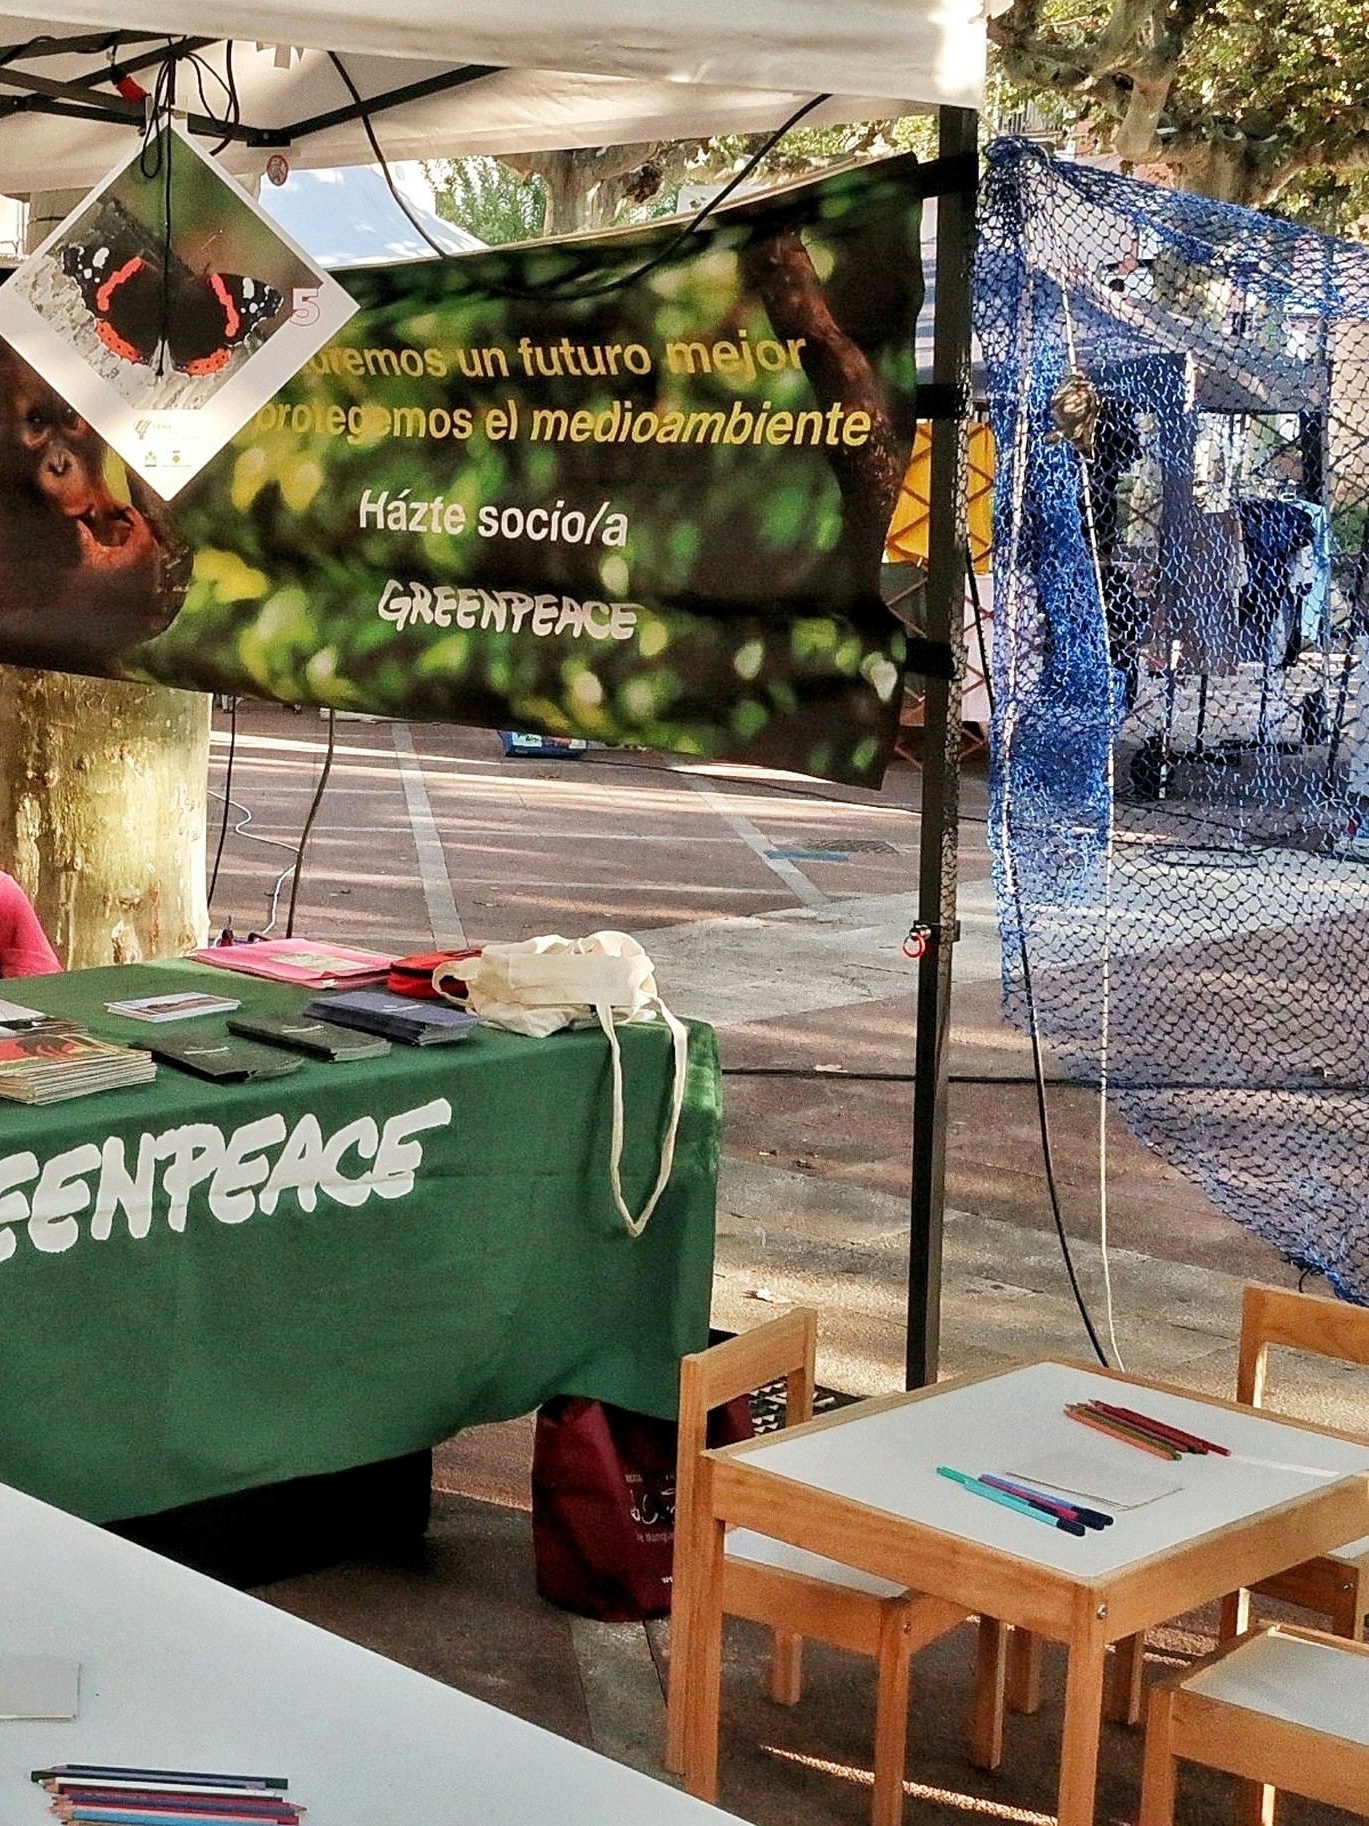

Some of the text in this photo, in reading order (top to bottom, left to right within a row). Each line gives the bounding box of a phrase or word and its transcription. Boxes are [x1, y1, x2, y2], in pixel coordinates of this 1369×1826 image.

[291, 287, 321, 326] 5
[304, 331, 806, 385] uremos un futuro mejor
[248, 398, 871, 447] protegemos el medioambiente
[358, 489, 629, 547] Házte socio/a
[378, 580, 647, 641] GREENPEACE
